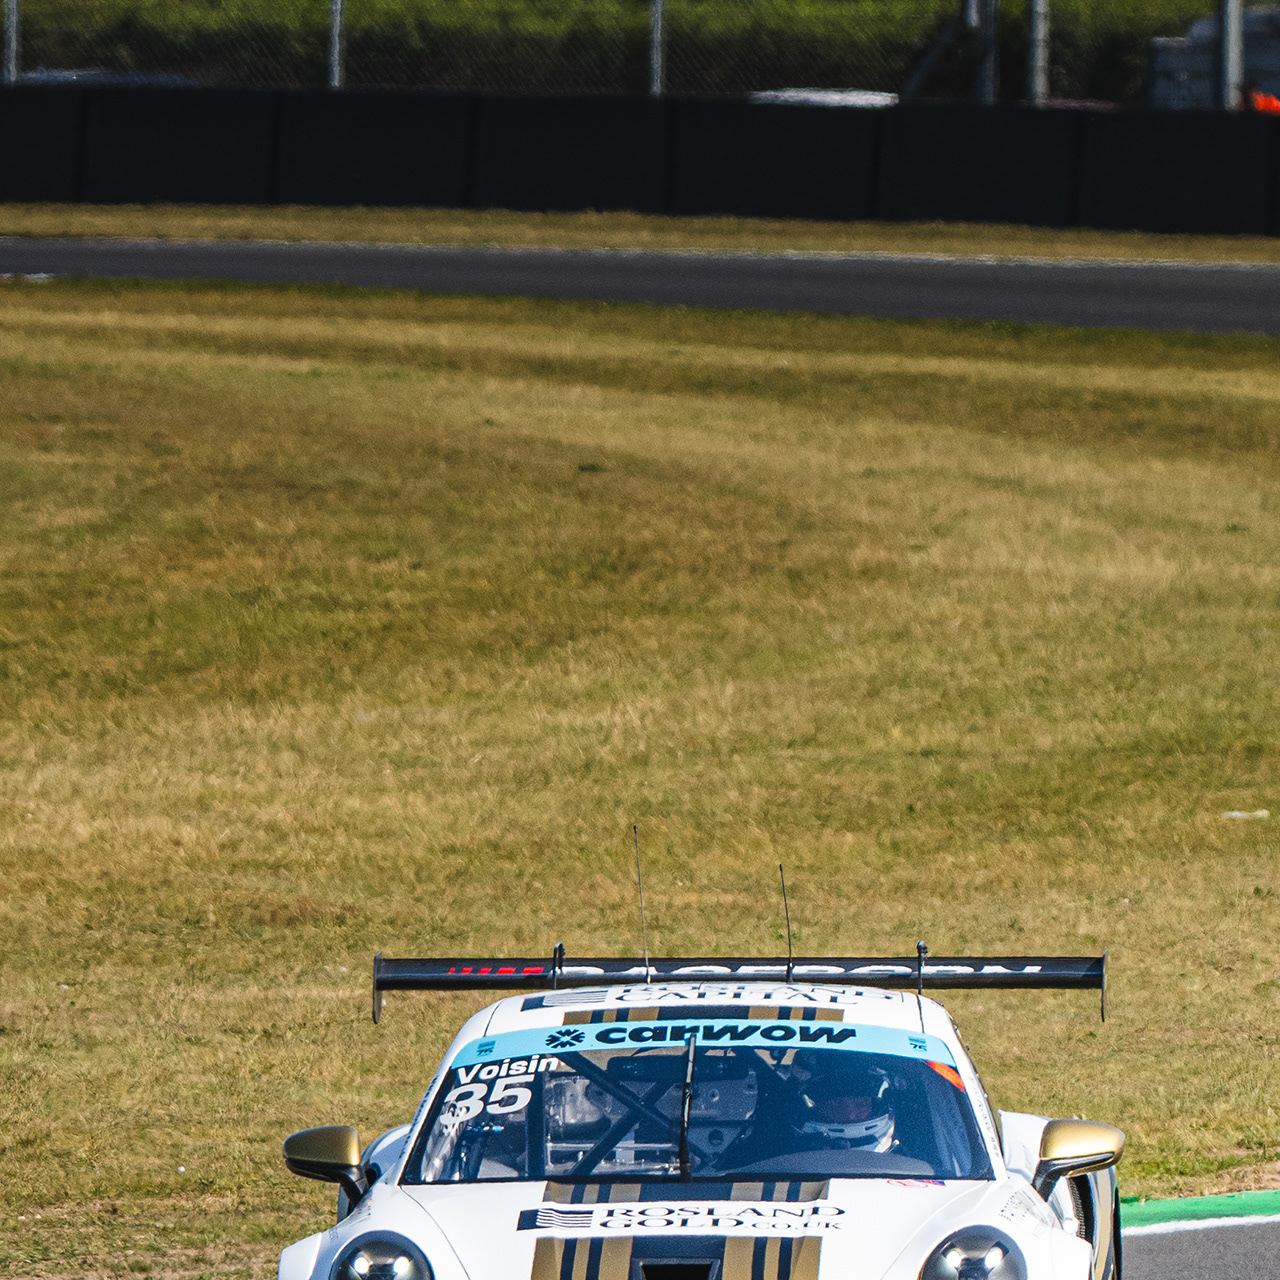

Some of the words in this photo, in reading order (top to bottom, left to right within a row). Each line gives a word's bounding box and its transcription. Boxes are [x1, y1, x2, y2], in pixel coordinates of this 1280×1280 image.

[596, 1023, 856, 1046] carwow
[457, 1055, 560, 1085] Voisin
[440, 1074, 536, 1127] 35
[604, 1205, 846, 1218] ROSLAND
